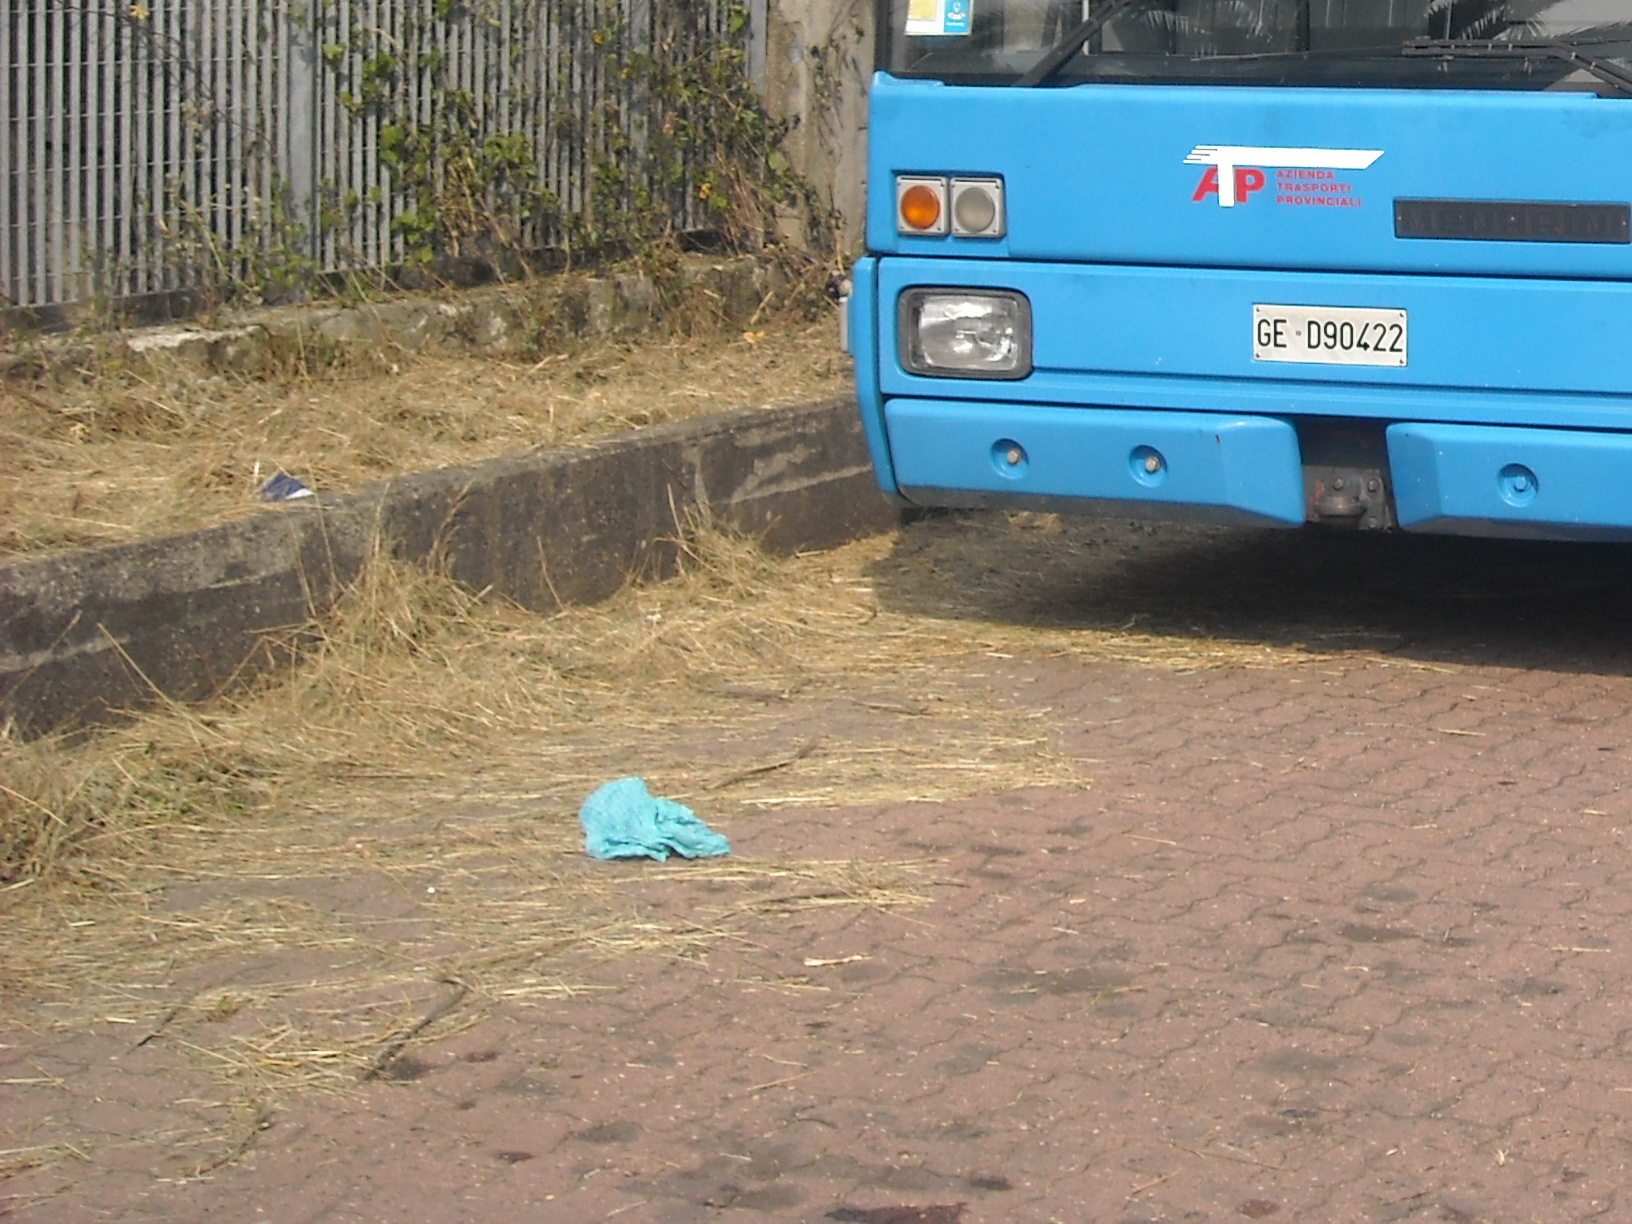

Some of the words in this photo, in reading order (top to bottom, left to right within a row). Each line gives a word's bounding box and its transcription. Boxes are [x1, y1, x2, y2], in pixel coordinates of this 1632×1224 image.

[1275, 168, 1335, 181] AZIENDA
[1275, 181, 1352, 195] TRASPORTI
[1275, 194, 1362, 208] PROVINCIALI
[1257, 318, 1287, 348] GE
[1307, 320, 1404, 353] D90422
